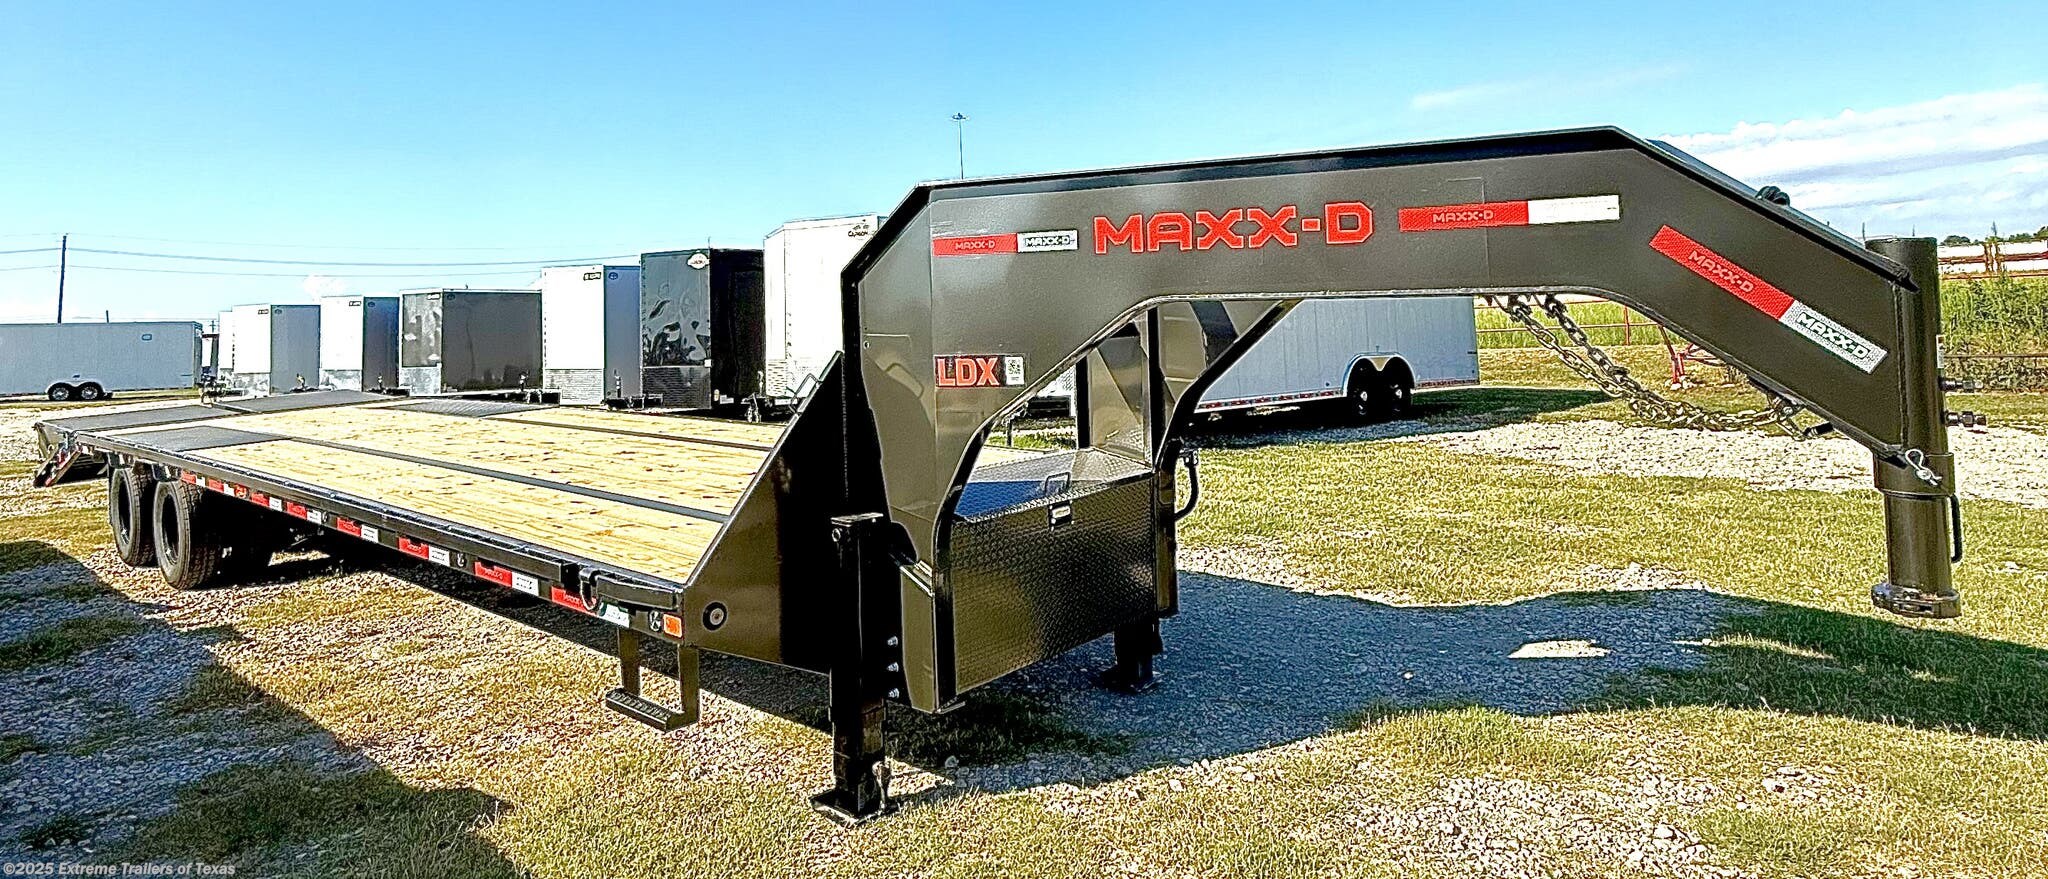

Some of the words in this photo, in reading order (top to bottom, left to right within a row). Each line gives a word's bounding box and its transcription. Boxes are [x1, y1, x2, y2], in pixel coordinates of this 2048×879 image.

[1094, 201, 1374, 254] MAXX-D
[1432, 209, 1494, 224] MAXX-D
[955, 240, 996, 250] MAXX-D
[1025, 235, 1071, 247] MAXX-D
[1688, 250, 1754, 293] MAXX-D
[1797, 312, 1869, 360] MAXX-D
[937, 357, 1000, 386] LDX
